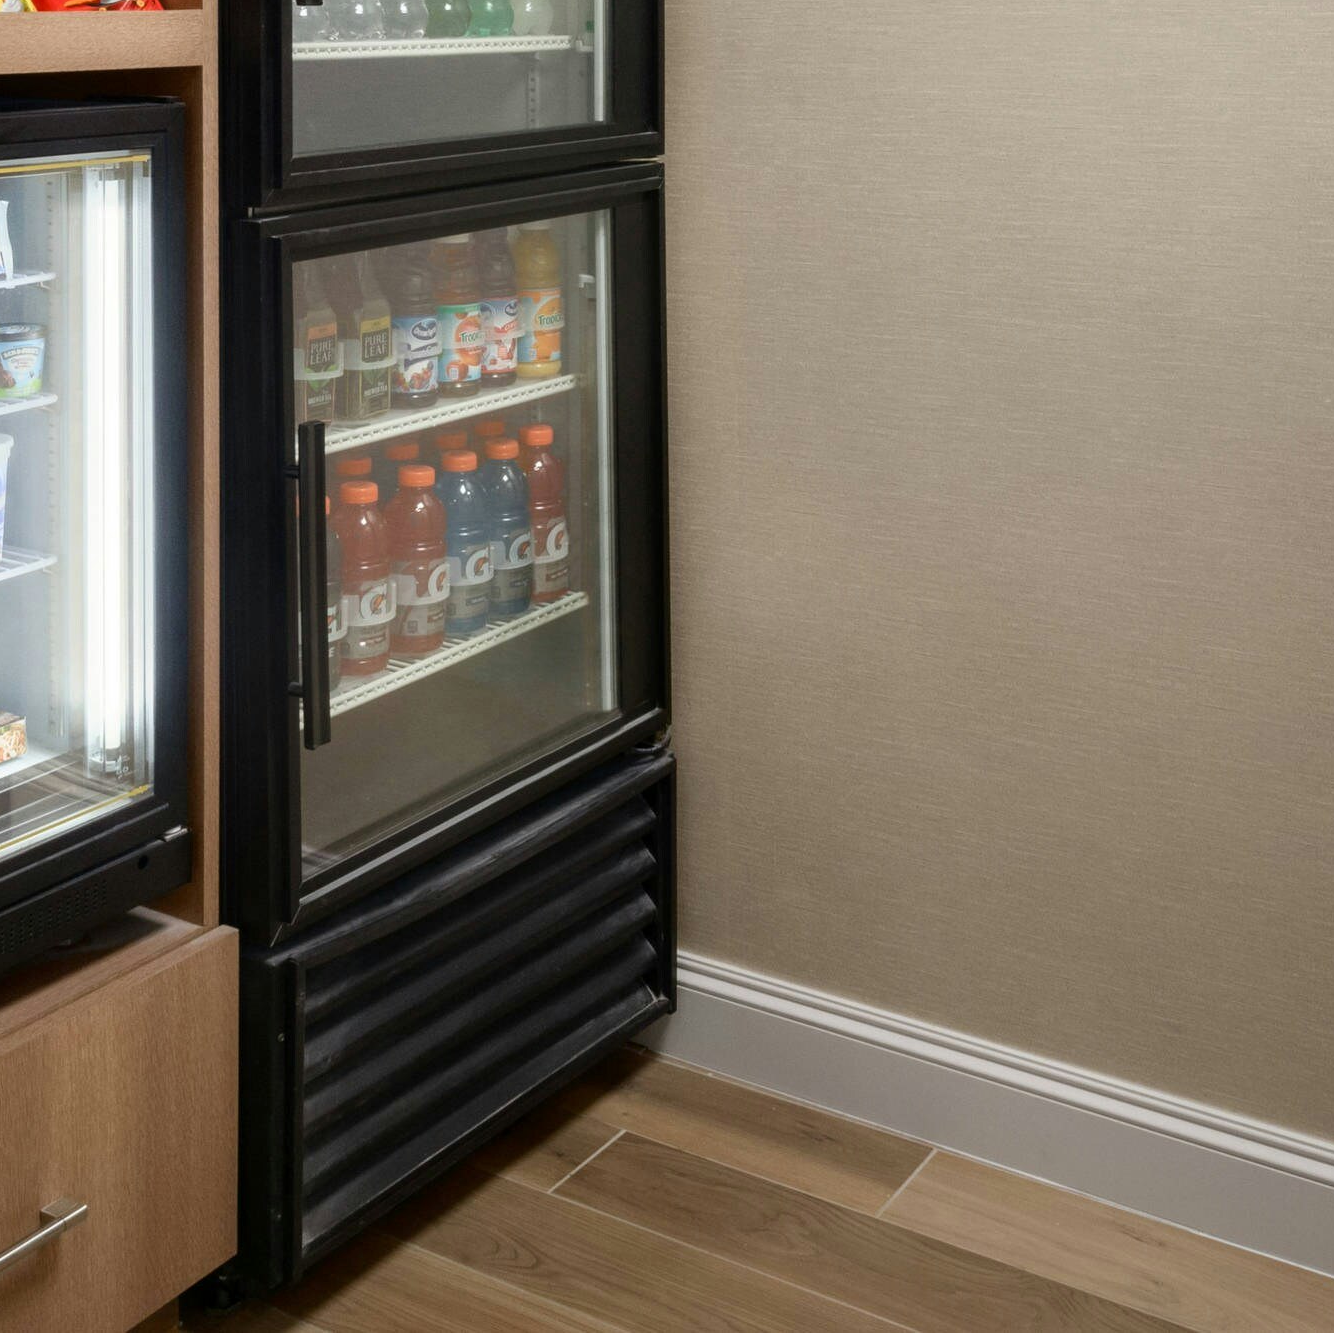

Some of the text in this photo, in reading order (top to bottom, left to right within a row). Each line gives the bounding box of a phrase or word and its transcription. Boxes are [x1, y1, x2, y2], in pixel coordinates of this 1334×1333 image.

[310, 338, 334, 352] PURE
[364, 332, 388, 347] PURE
[310, 351, 333, 365] LEAF
[364, 345, 388, 358] LEAF
